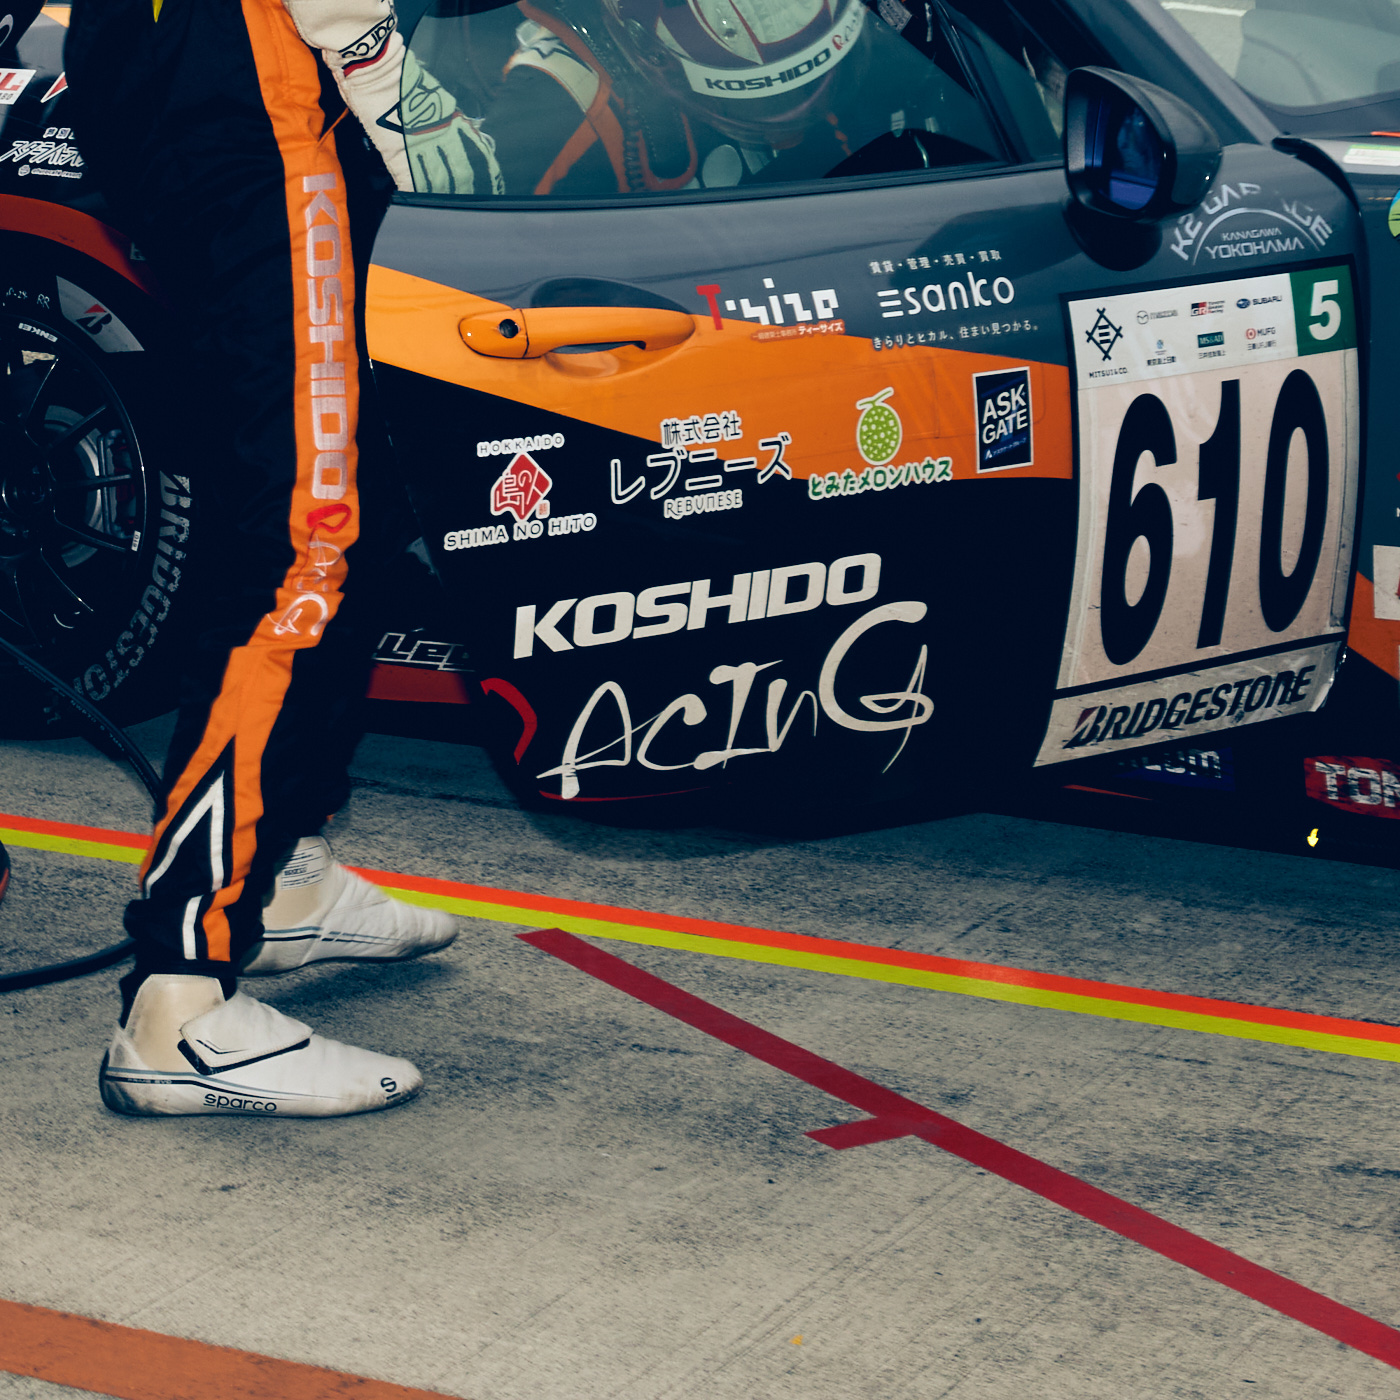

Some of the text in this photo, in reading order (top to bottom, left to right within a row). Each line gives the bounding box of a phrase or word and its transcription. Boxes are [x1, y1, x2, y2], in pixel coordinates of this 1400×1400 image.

[704, 48, 832, 92] KOSHIDO
[1169, 212, 1204, 261] K2
[1205, 236, 1305, 260] YOKOHAMA
[1222, 227, 1282, 241] KANAGAWA
[1253, 295, 1283, 306] SUBARU
[1308, 280, 1340, 341] 5
[17, 322, 59, 344] ENKEI
[302, 173, 350, 501] KOSHIDO
[797, 322, 843, 336] ティーサイズ
[872, 319, 1038, 350] きらりとヒカル、住まい見つかる。
[1257, 327, 1276, 337] MUFG
[982, 384, 1027, 424] ASK
[477, 433, 564, 456] HOKKAIDO
[662, 413, 742, 446] 株式会社
[982, 409, 1029, 445] GATE
[611, 435, 790, 505] レブニーズ
[808, 458, 953, 500] とみたメロンハウス
[445, 513, 597, 551] SHIMA NO HITO
[1100, 369, 1330, 666] 610
[514, 553, 882, 659] KOSHIDO
[1063, 666, 1317, 750] BRIDGESTONE
[202, 1093, 277, 1113] sparco
